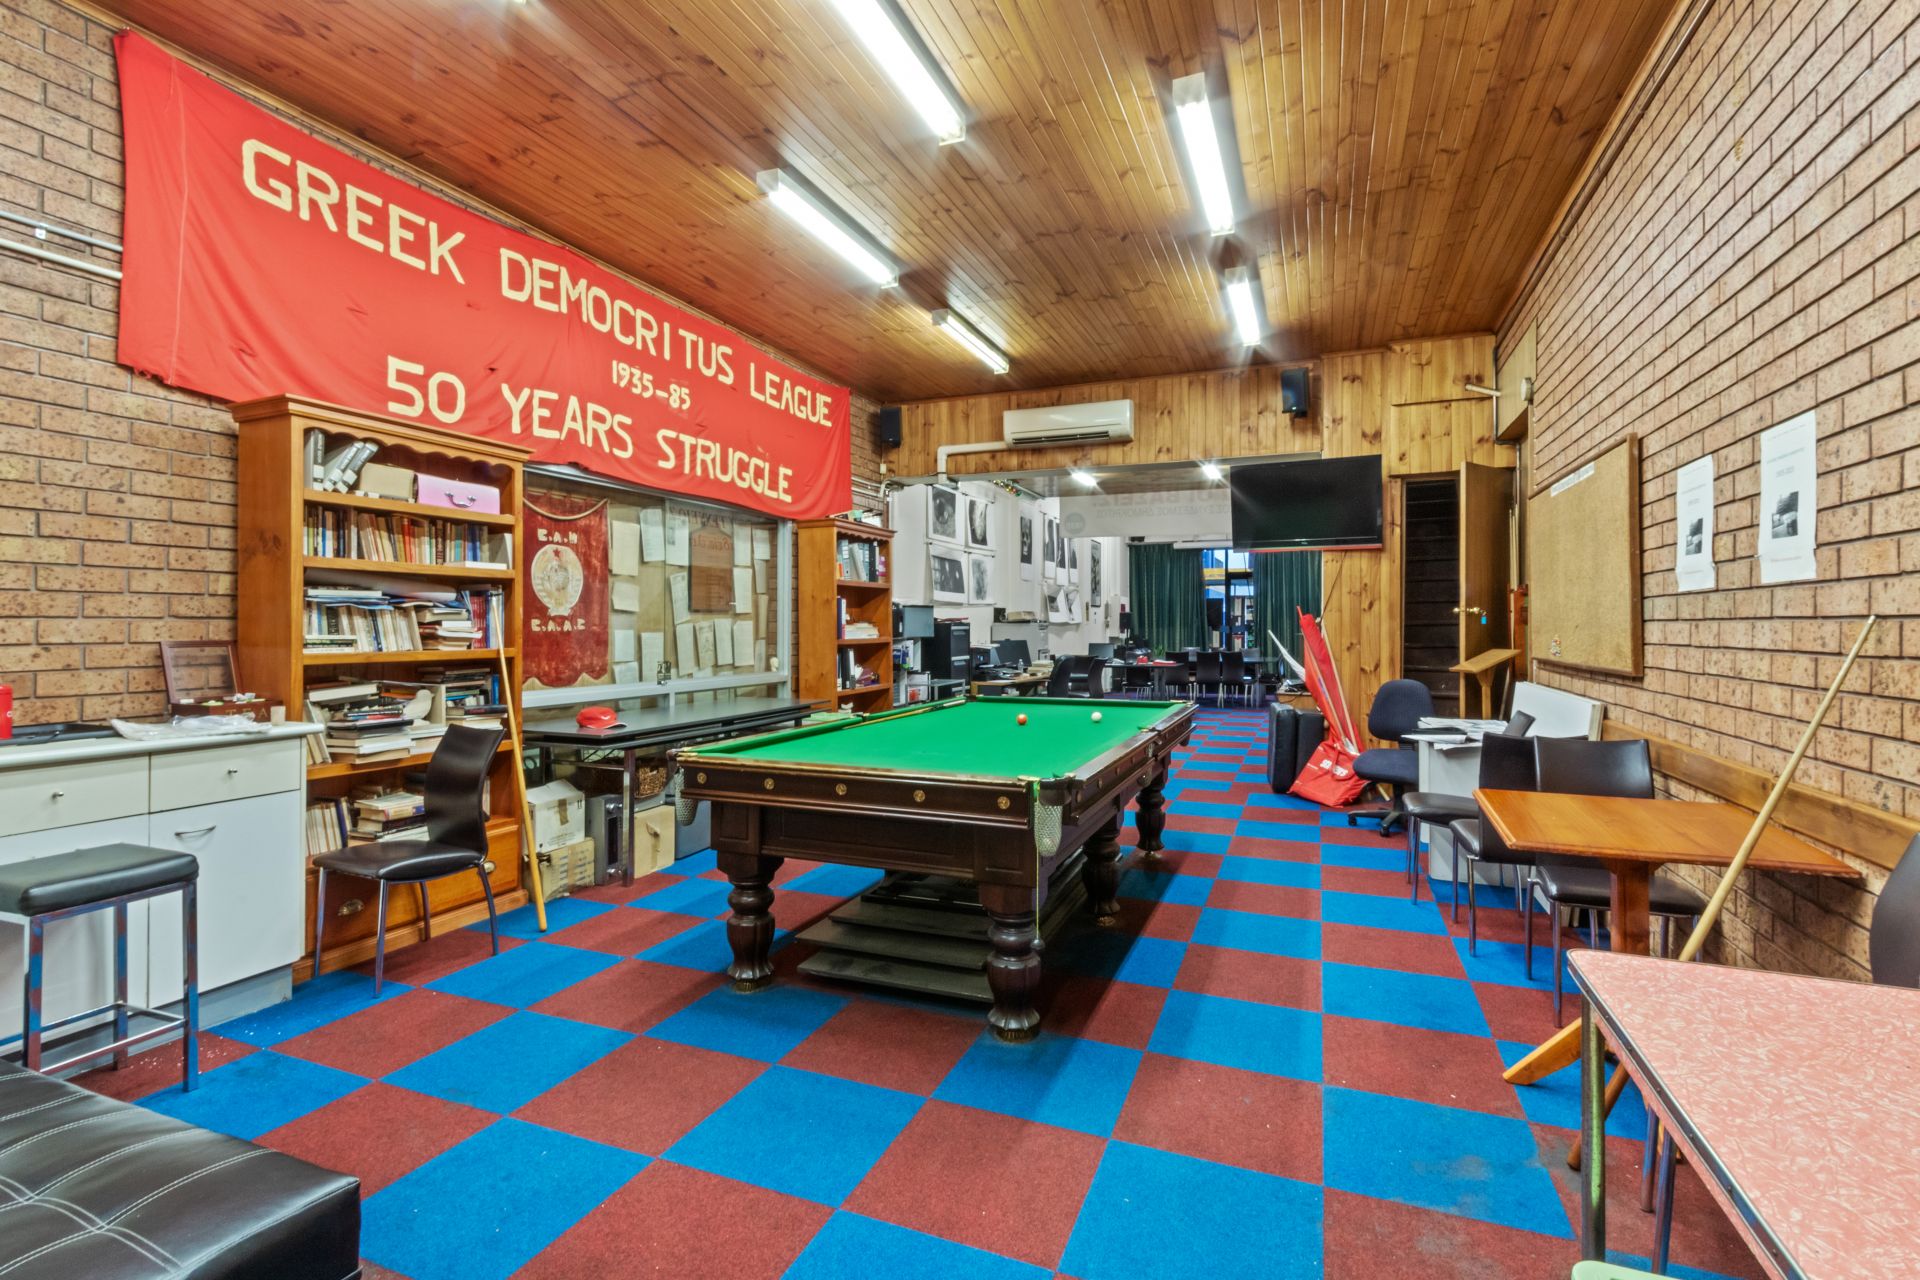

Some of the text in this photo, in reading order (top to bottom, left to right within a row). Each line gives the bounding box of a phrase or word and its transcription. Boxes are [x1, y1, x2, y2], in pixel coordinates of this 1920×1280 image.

[241, 139, 833, 427] GREEK DEMOCRITUS LEAGUE
[386, 355, 793, 503] 50 YEARS STRUGGLE
[611, 359, 692, 411] 1935-85
